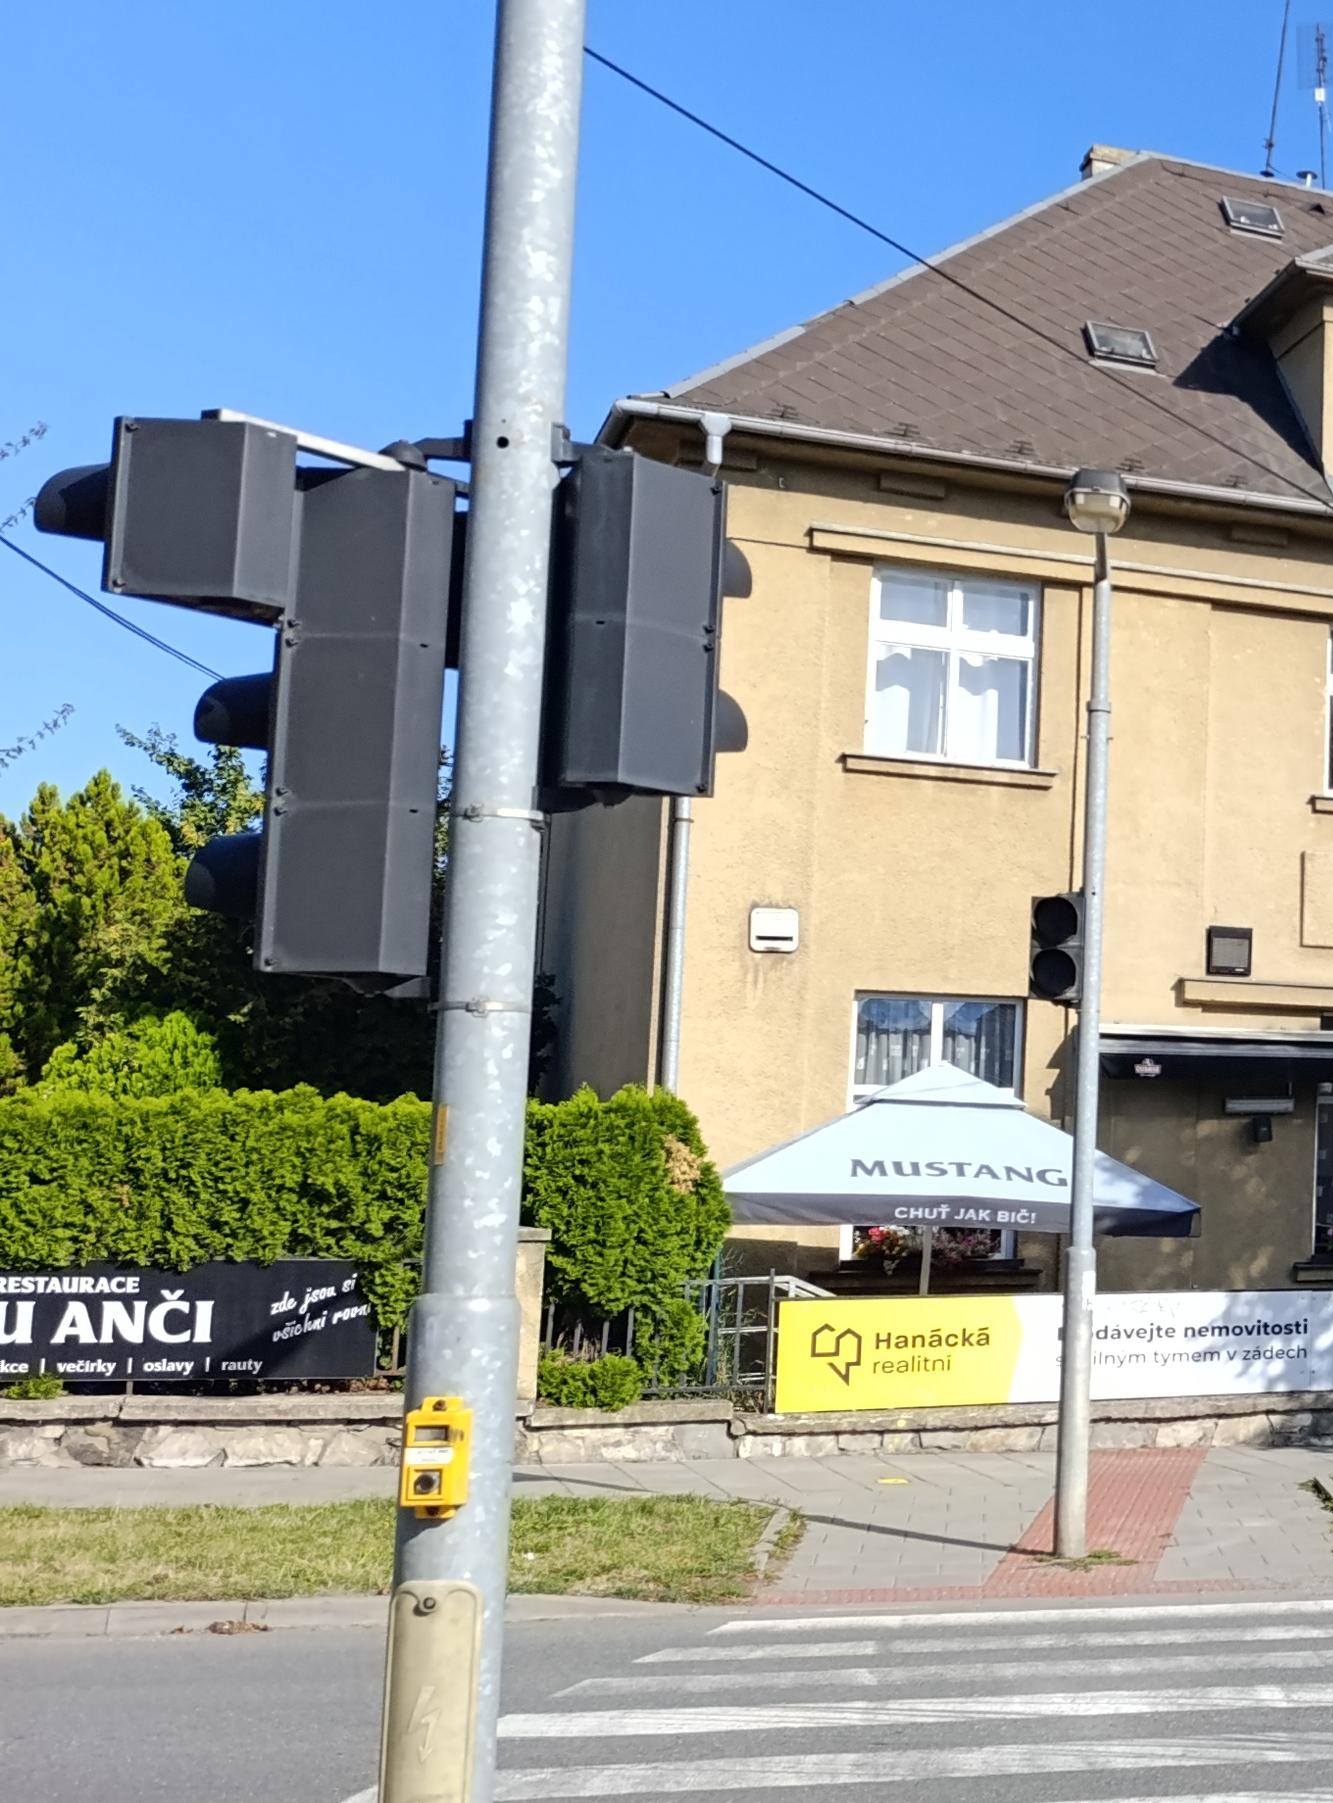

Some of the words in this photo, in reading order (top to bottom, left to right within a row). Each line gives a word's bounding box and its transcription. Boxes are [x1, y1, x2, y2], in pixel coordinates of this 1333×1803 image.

[850, 1159, 1069, 1187] MUSTANG
[894, 1204, 950, 1219] CHUŤ
[953, 1208, 991, 1221] JAK
[996, 1209, 1036, 1224] BIČ!
[270, 1291, 298, 1316] zde
[299, 1286, 337, 1315] jsou
[342, 1273, 358, 1293] si
[0, 1301, 36, 1344] U
[50, 1289, 215, 1344] ANČI
[875, 1327, 990, 1349] Hanácká
[1184, 1319, 1309, 1338] nemovitosti
[1227, 1348, 1237, 1361] v
[1242, 1345, 1308, 1361] zádech
[57, 1358, 117, 1376] večírky
[143, 1358, 195, 1375] oslavy
[221, 1358, 263, 1374] rauty
[872, 1355, 951, 1374] realitní
